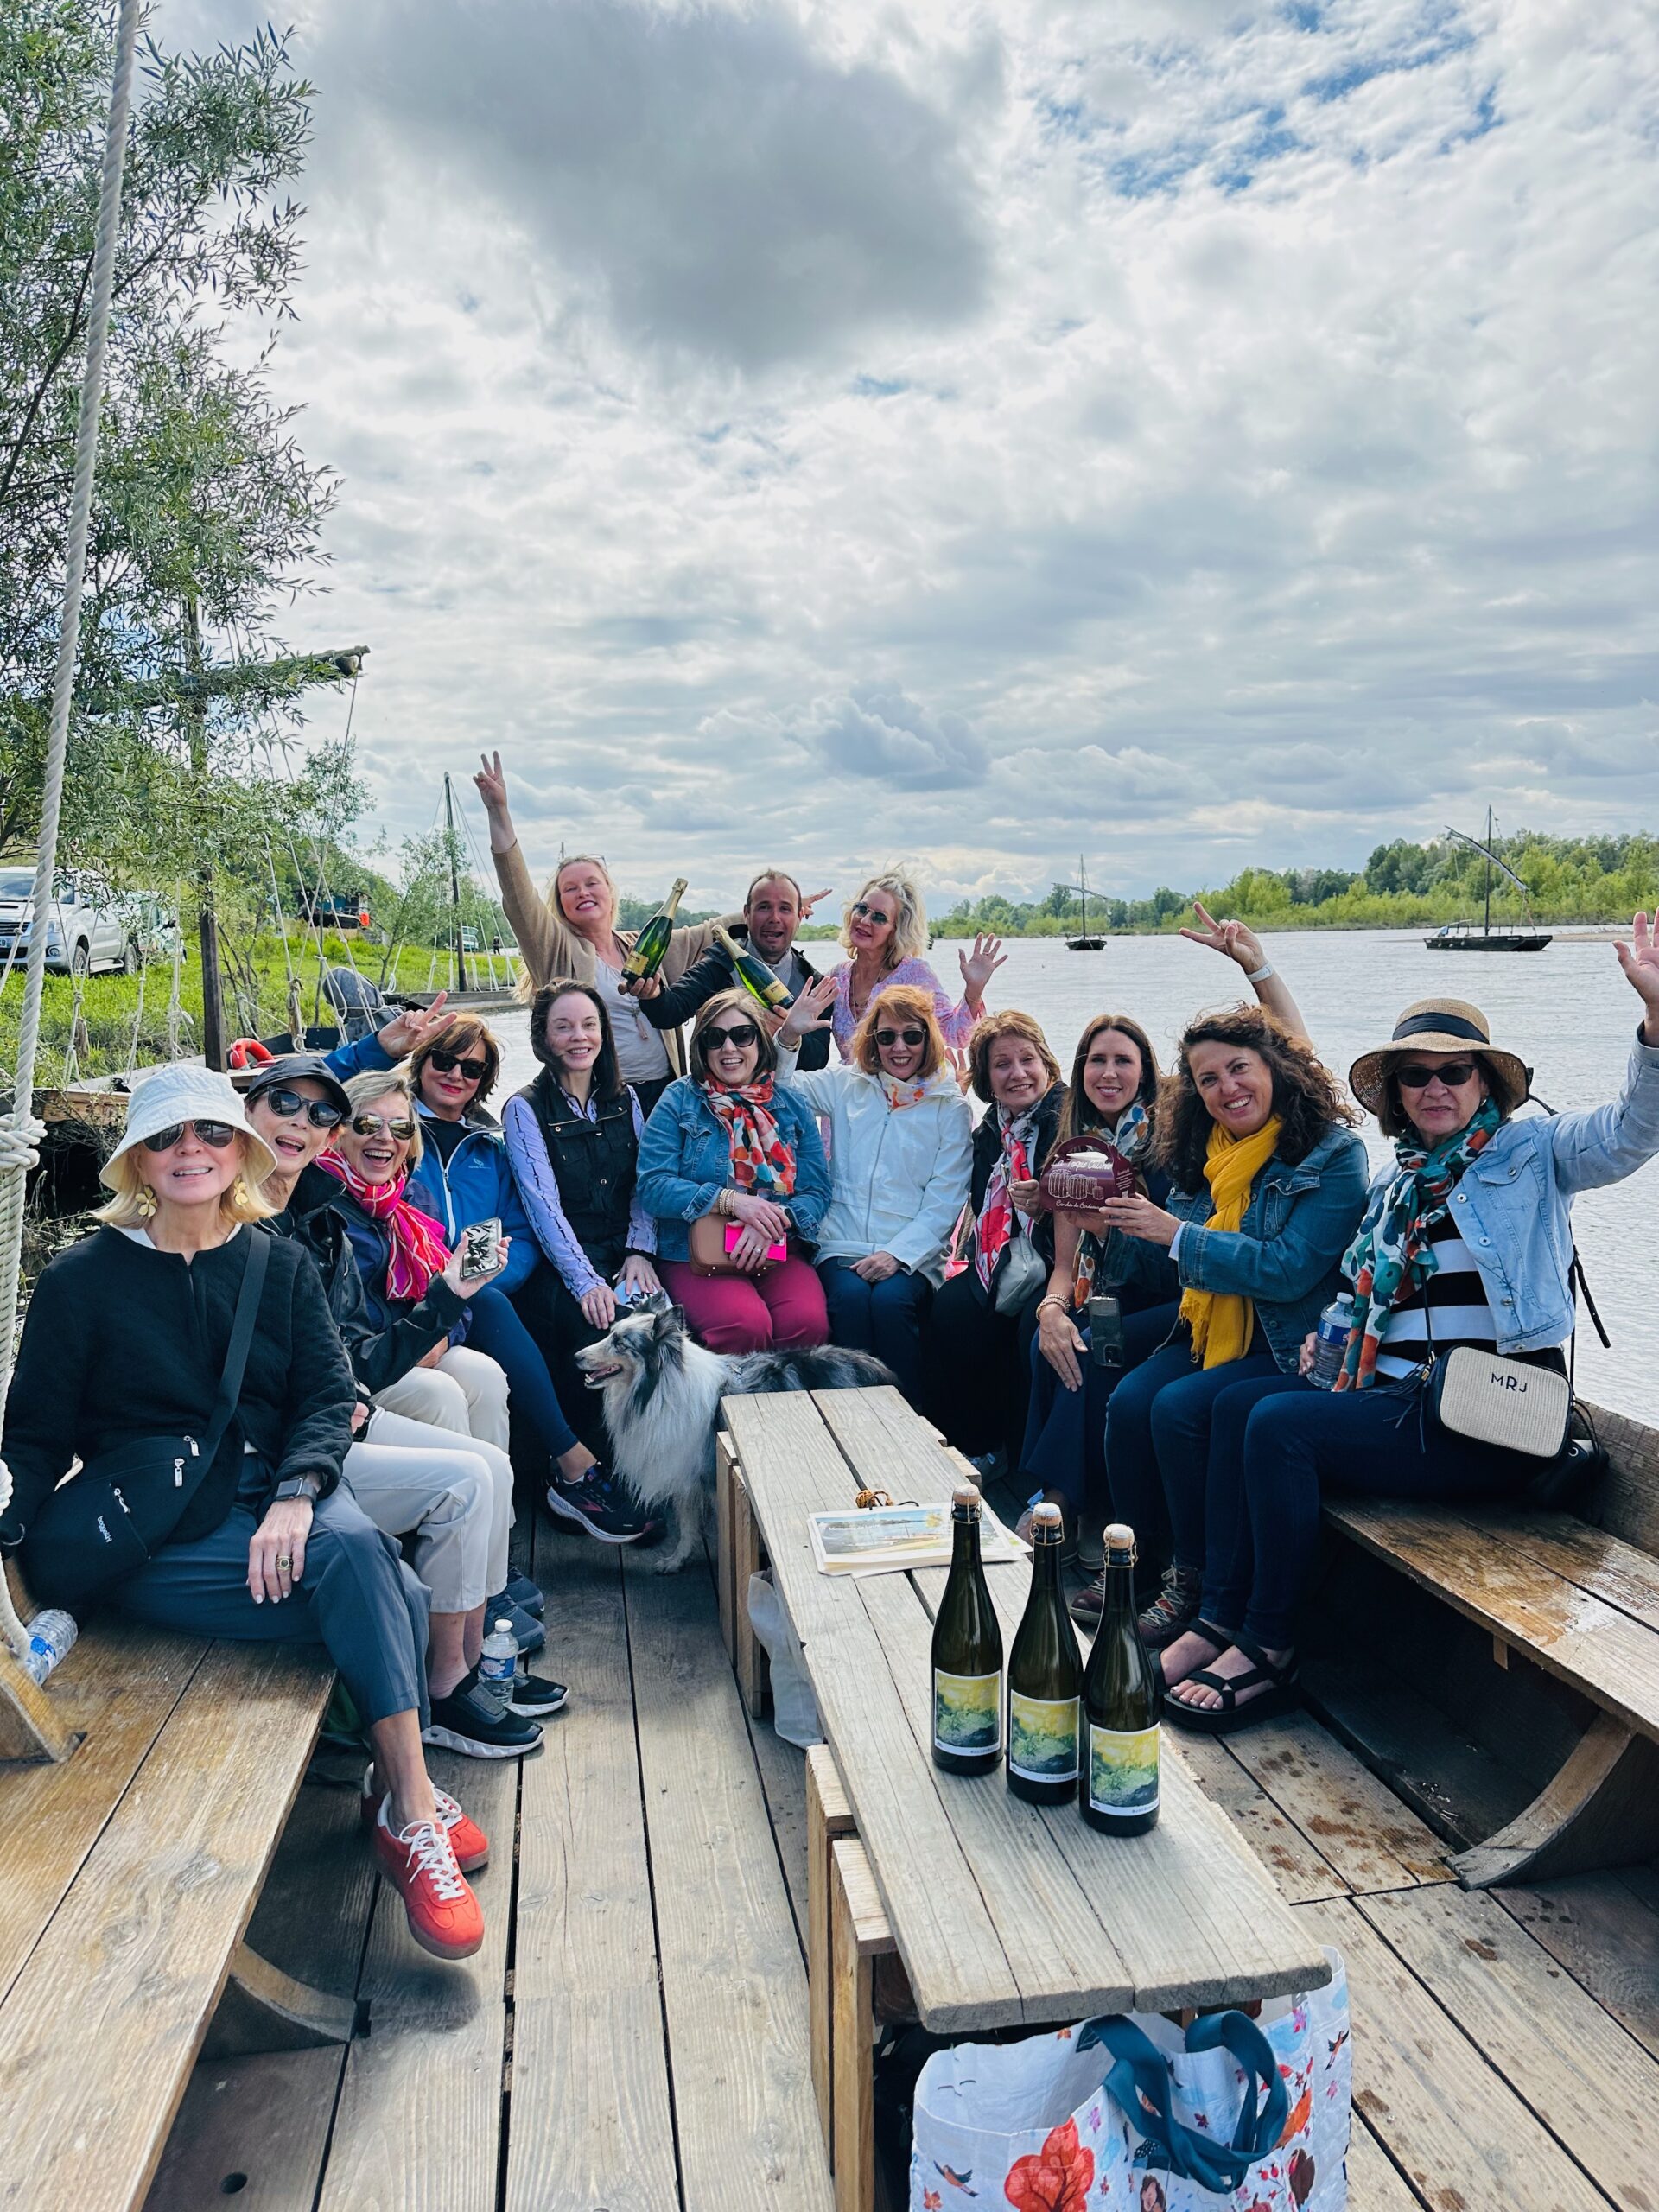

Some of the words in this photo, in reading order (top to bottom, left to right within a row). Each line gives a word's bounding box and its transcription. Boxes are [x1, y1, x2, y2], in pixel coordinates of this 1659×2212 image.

[1051, 1158, 1065, 1167] La
[1067, 1159, 1087, 1172] Toque
[1491, 1372, 1528, 1393] MRJ
